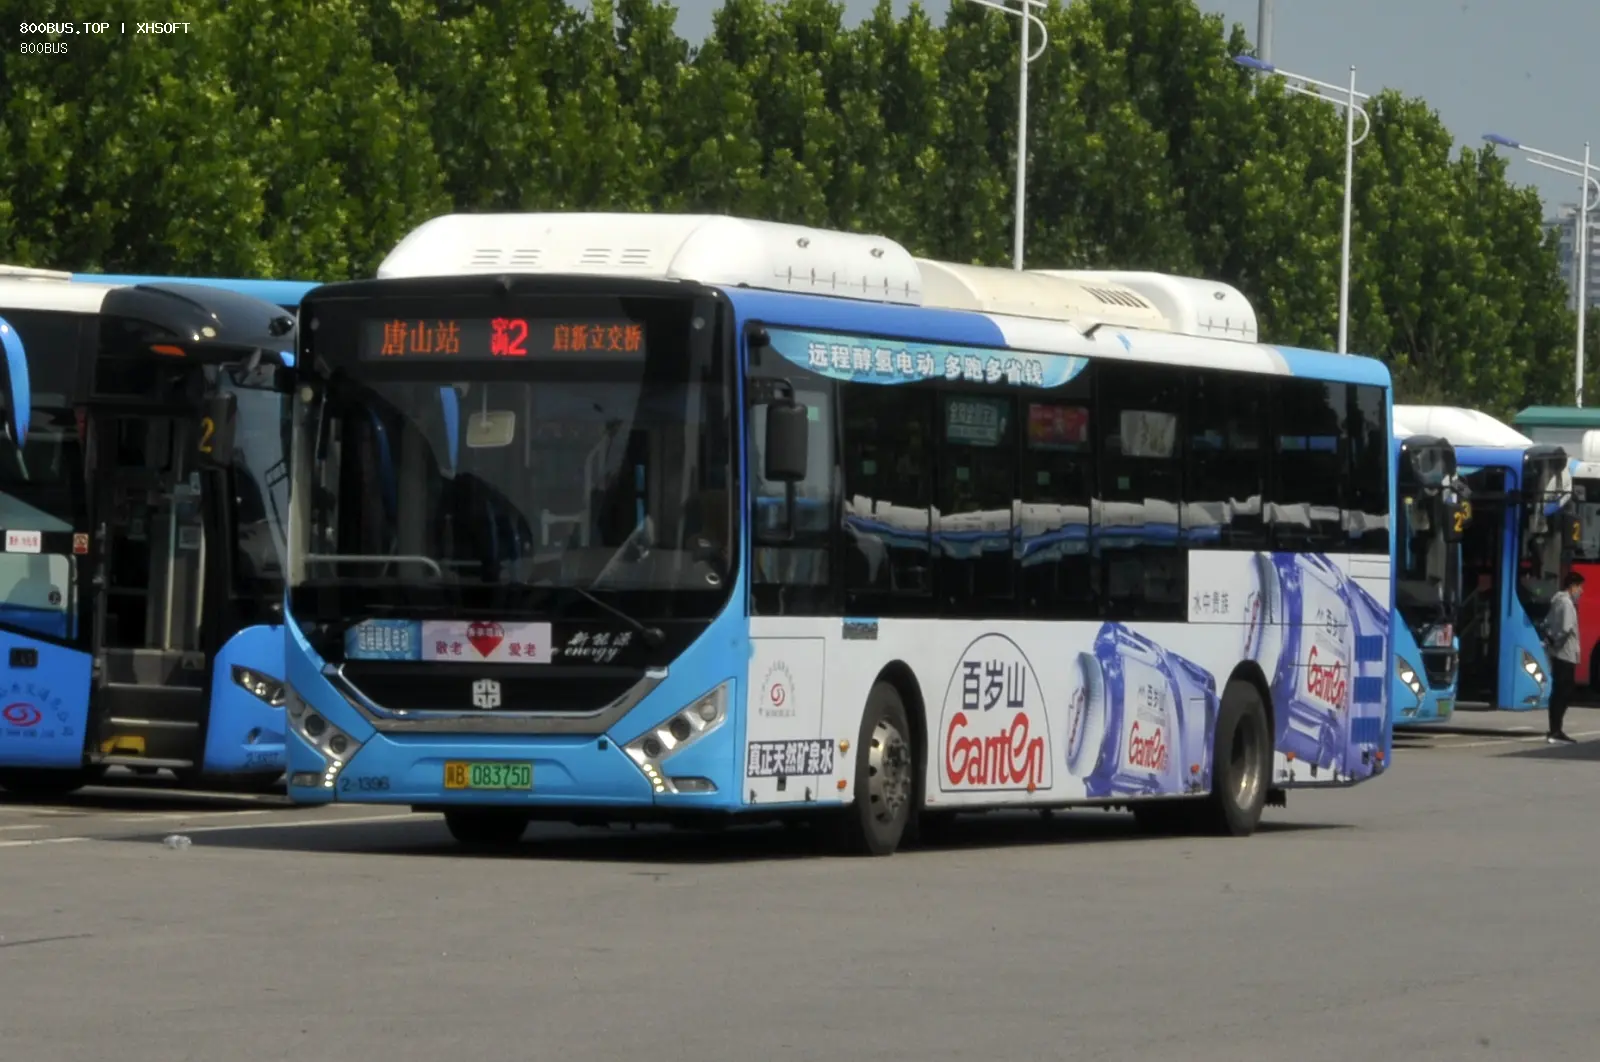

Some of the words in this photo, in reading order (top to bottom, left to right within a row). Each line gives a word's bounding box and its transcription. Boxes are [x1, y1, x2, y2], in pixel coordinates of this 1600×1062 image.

[380, 319, 461, 356] 唐山站
[944, 355, 1044, 385] 多跑多省钱
[199, 417, 215, 453] 2
[1454, 511, 1464, 532] 2
[962, 659, 1026, 711] 百岁山
[748, 741, 832, 776] 真正天然矿泉水
